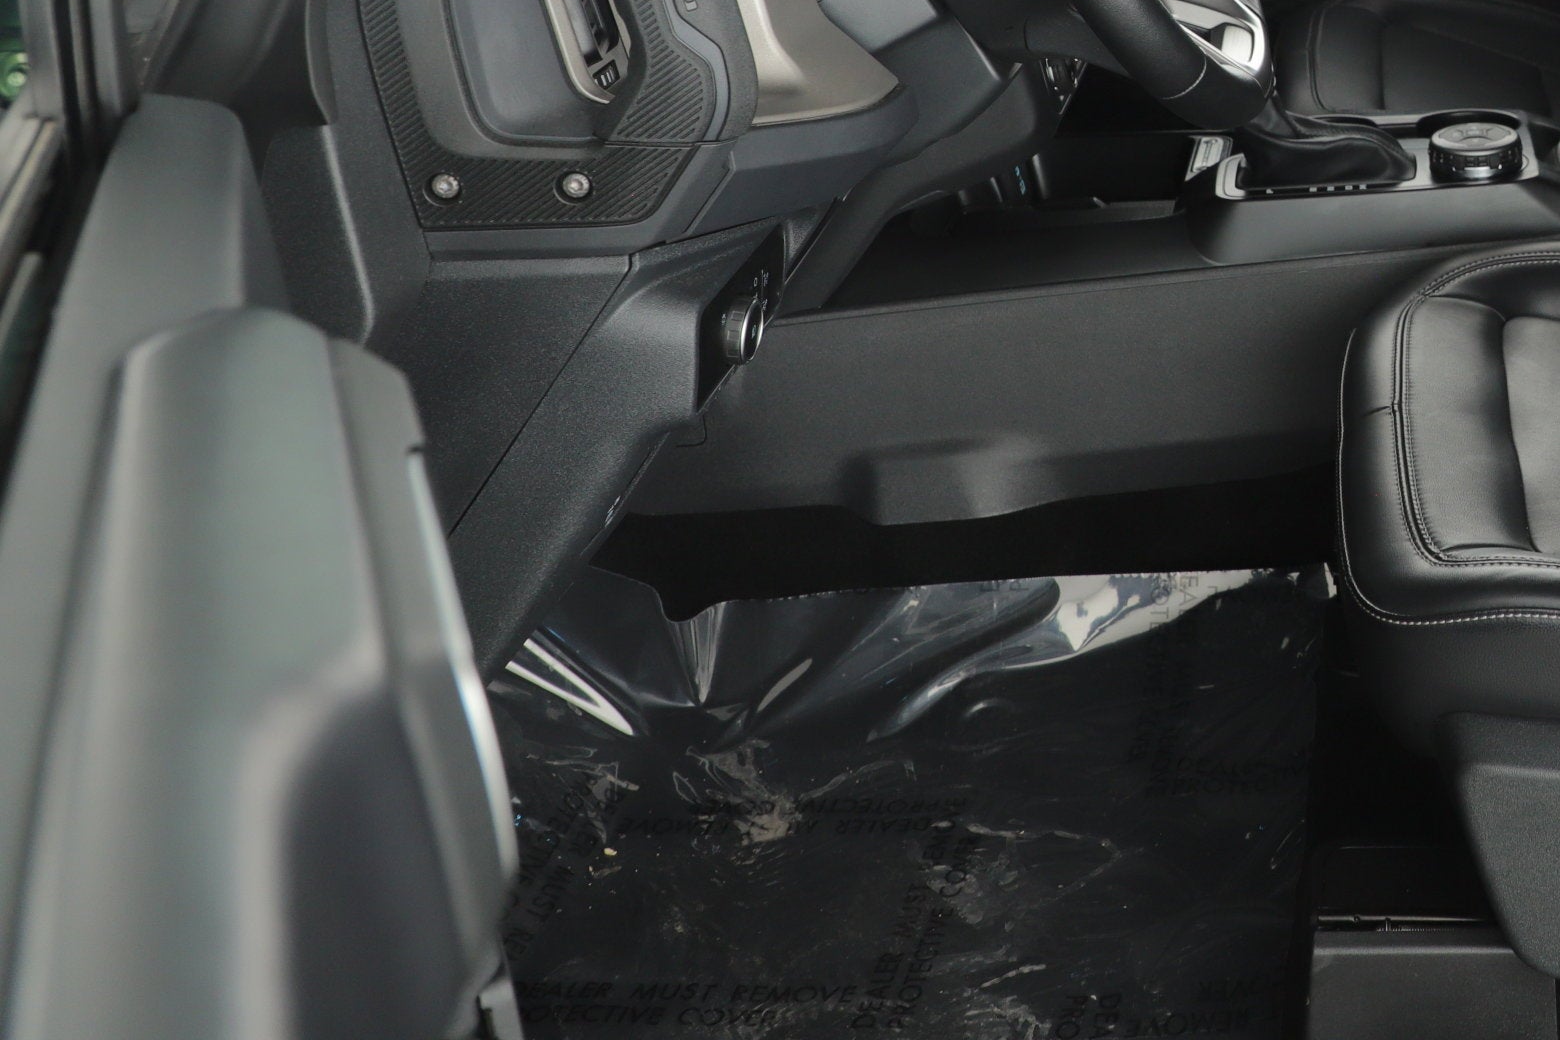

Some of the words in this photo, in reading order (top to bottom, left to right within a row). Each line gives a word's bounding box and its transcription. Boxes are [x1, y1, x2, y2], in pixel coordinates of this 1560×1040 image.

[630, 983, 719, 1002] MUST
[730, 984, 857, 1004] REMOVE
[521, 1004, 666, 1026] OTECTIVE
